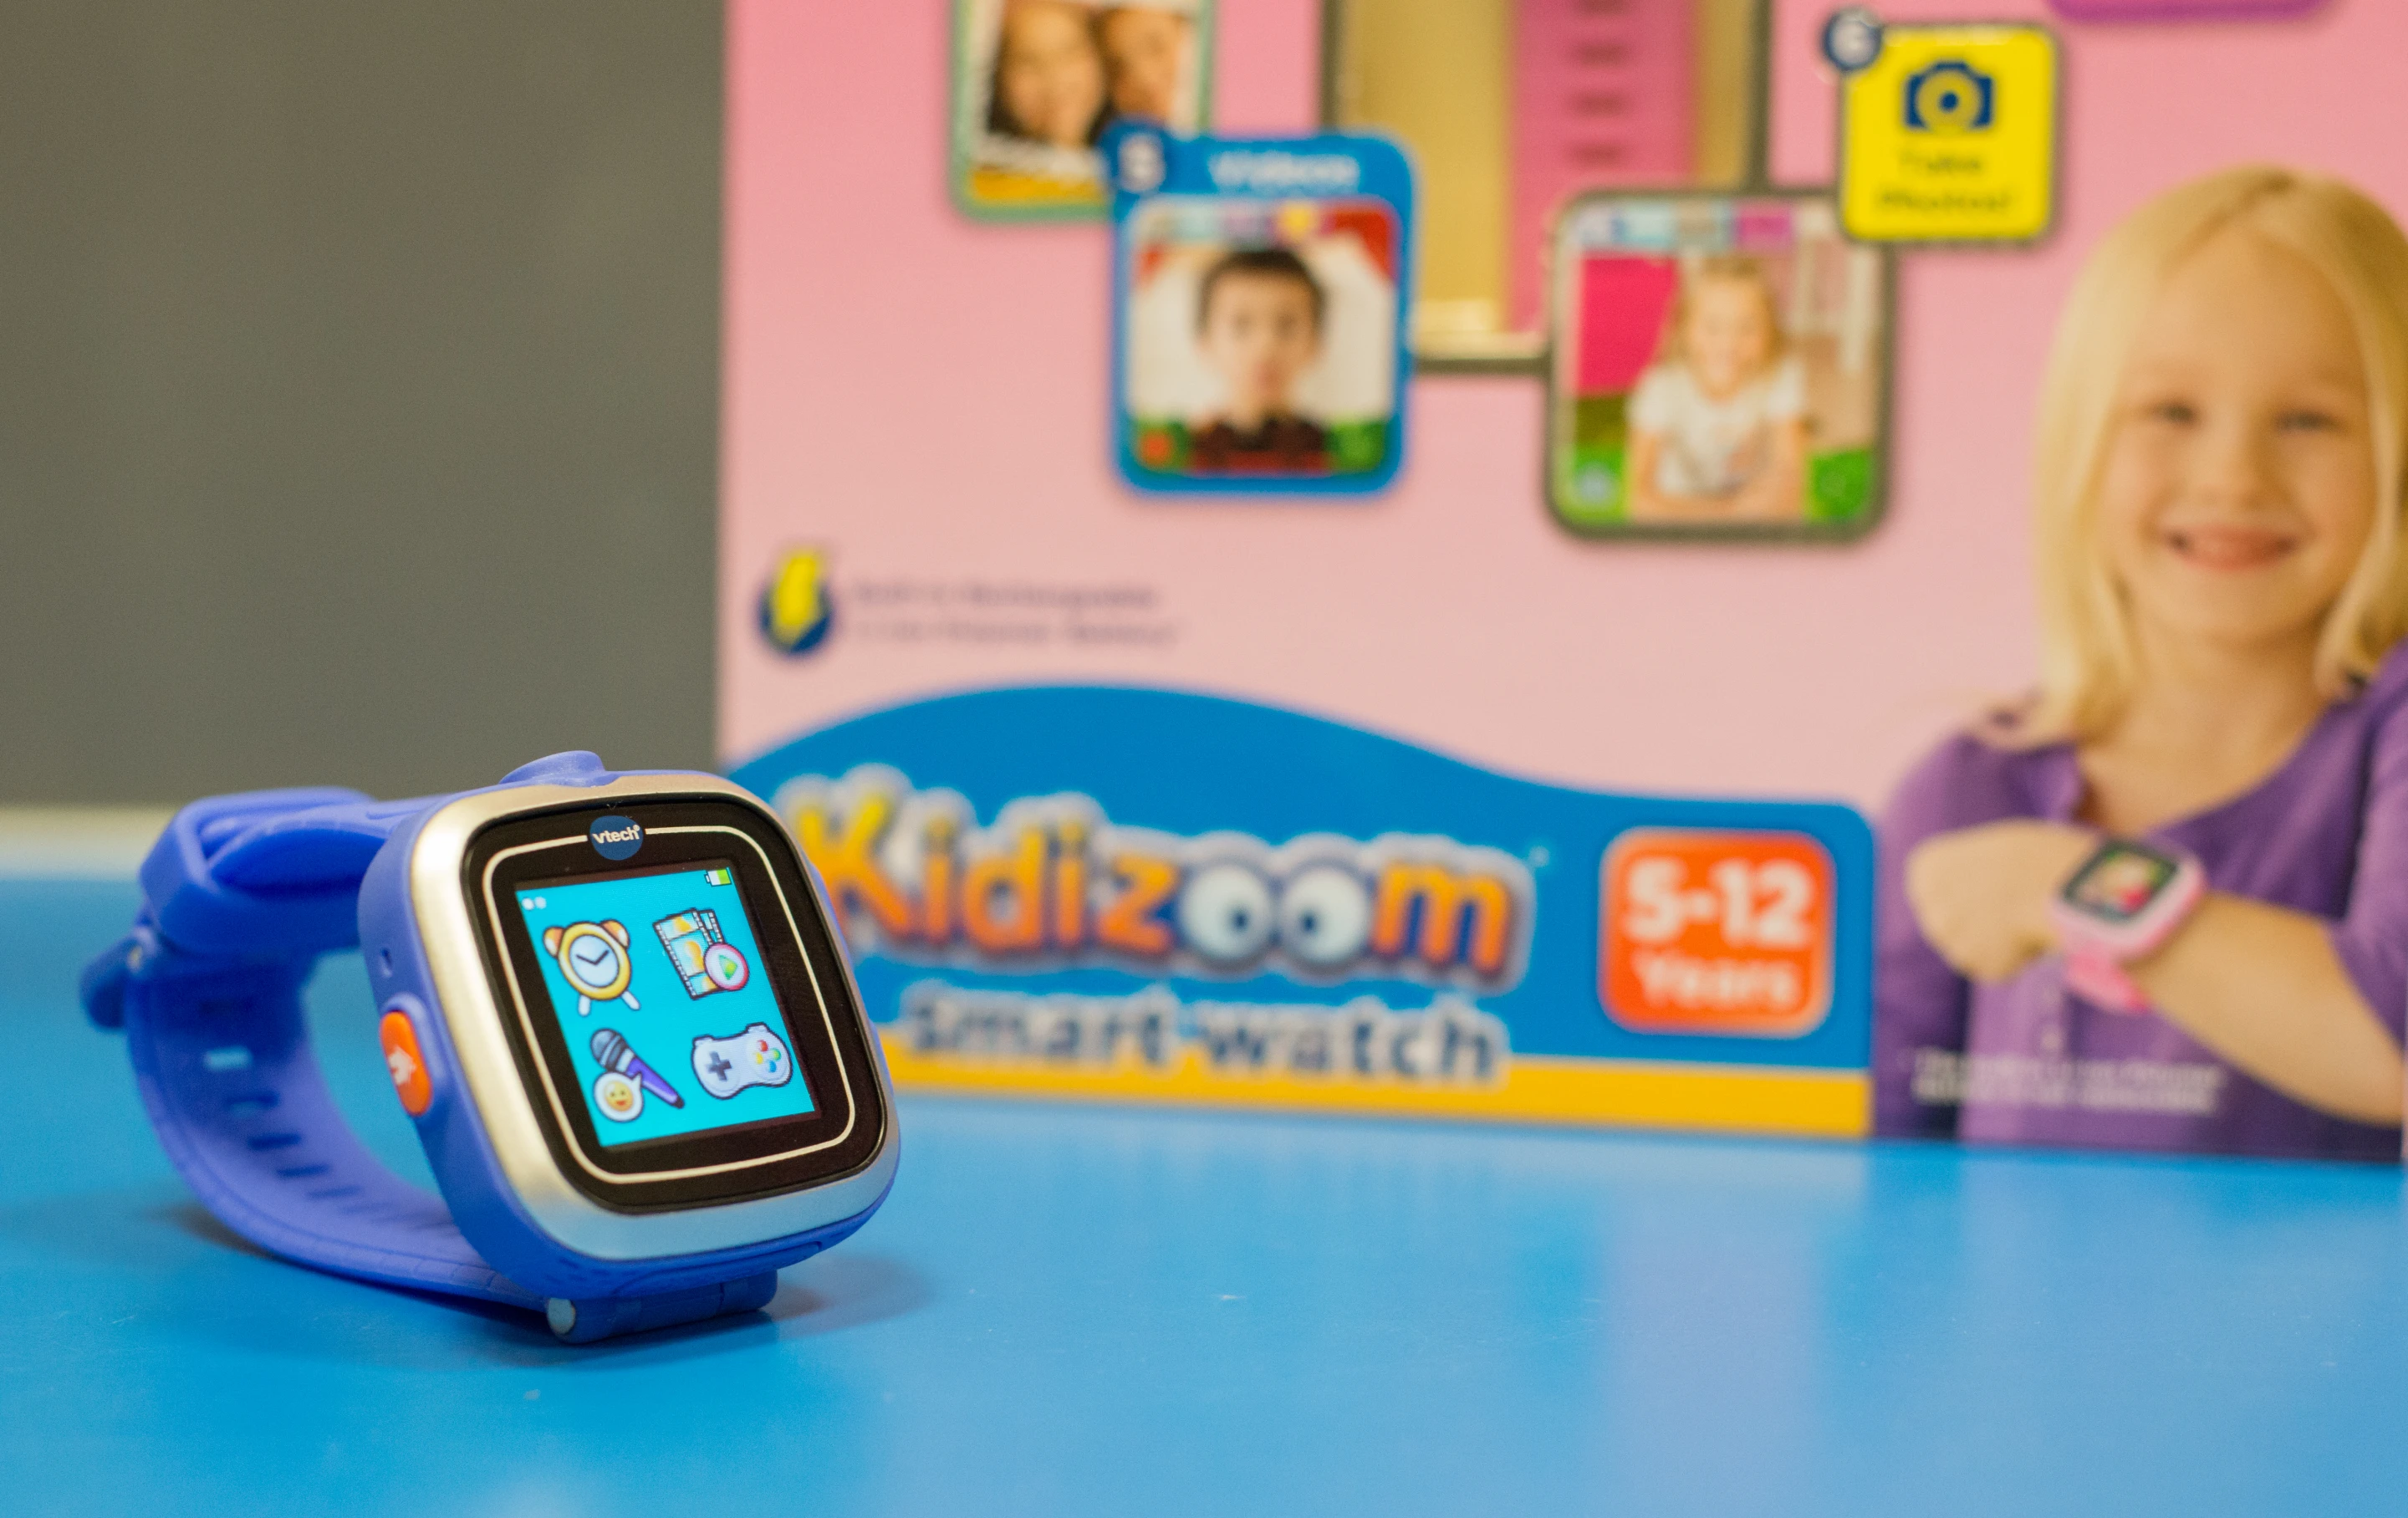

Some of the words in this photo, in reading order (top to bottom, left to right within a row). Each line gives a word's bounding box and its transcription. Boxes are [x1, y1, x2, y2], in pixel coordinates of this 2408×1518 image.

[592, 825, 640, 844] vtech
[782, 776, 1528, 985] Kidizoom
[1624, 857, 1814, 949] 5-12
[1632, 953, 1801, 1009] Years
[905, 989, 1169, 1070] smart
[1201, 1006, 1500, 1081] watch
